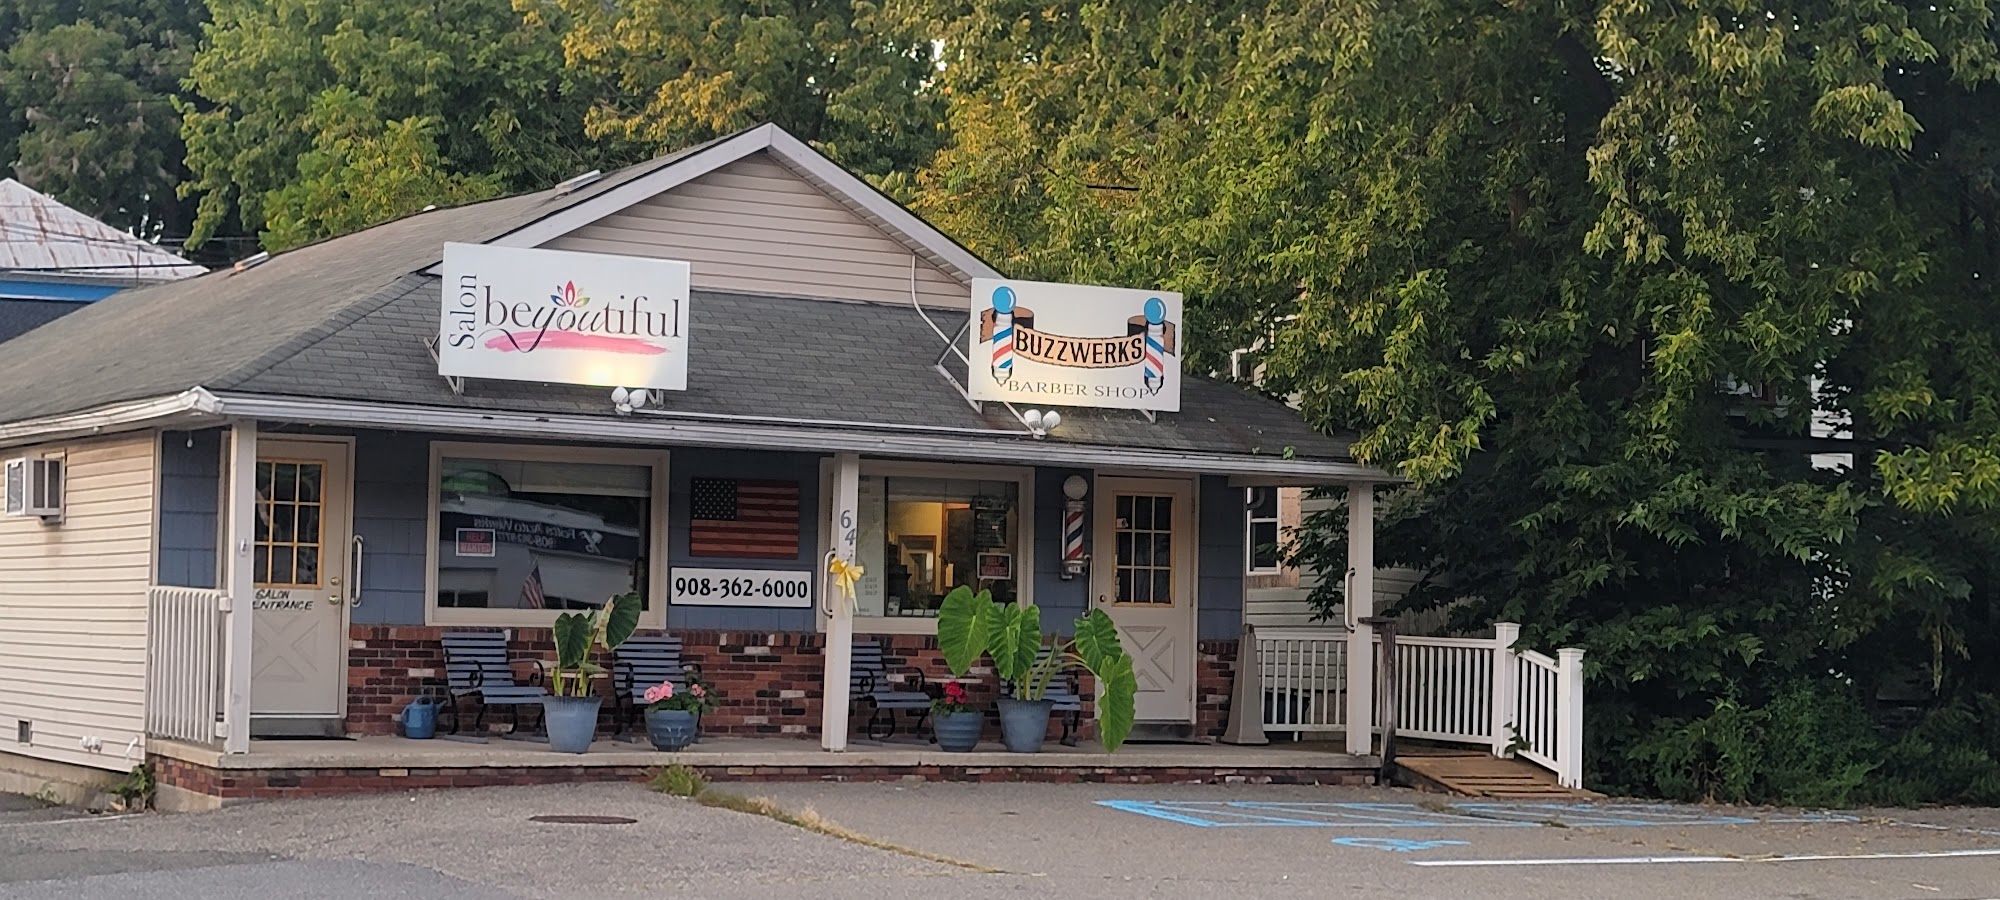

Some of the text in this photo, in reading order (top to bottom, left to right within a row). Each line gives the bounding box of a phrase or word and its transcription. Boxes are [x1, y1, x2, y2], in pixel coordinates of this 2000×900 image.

[448, 273, 477, 349] Salon
[477, 285, 681, 353] beyoutiful
[1015, 329, 1143, 364] BUZZWERKS
[1008, 380, 1149, 399] BARBER SHOP
[466, 531, 487, 542] HELP
[459, 542, 492, 553] WANTED
[255, 589, 291, 600] SALON
[675, 577, 808, 598] 908-362-6000
[252, 600, 314, 611] ENTRANCE
